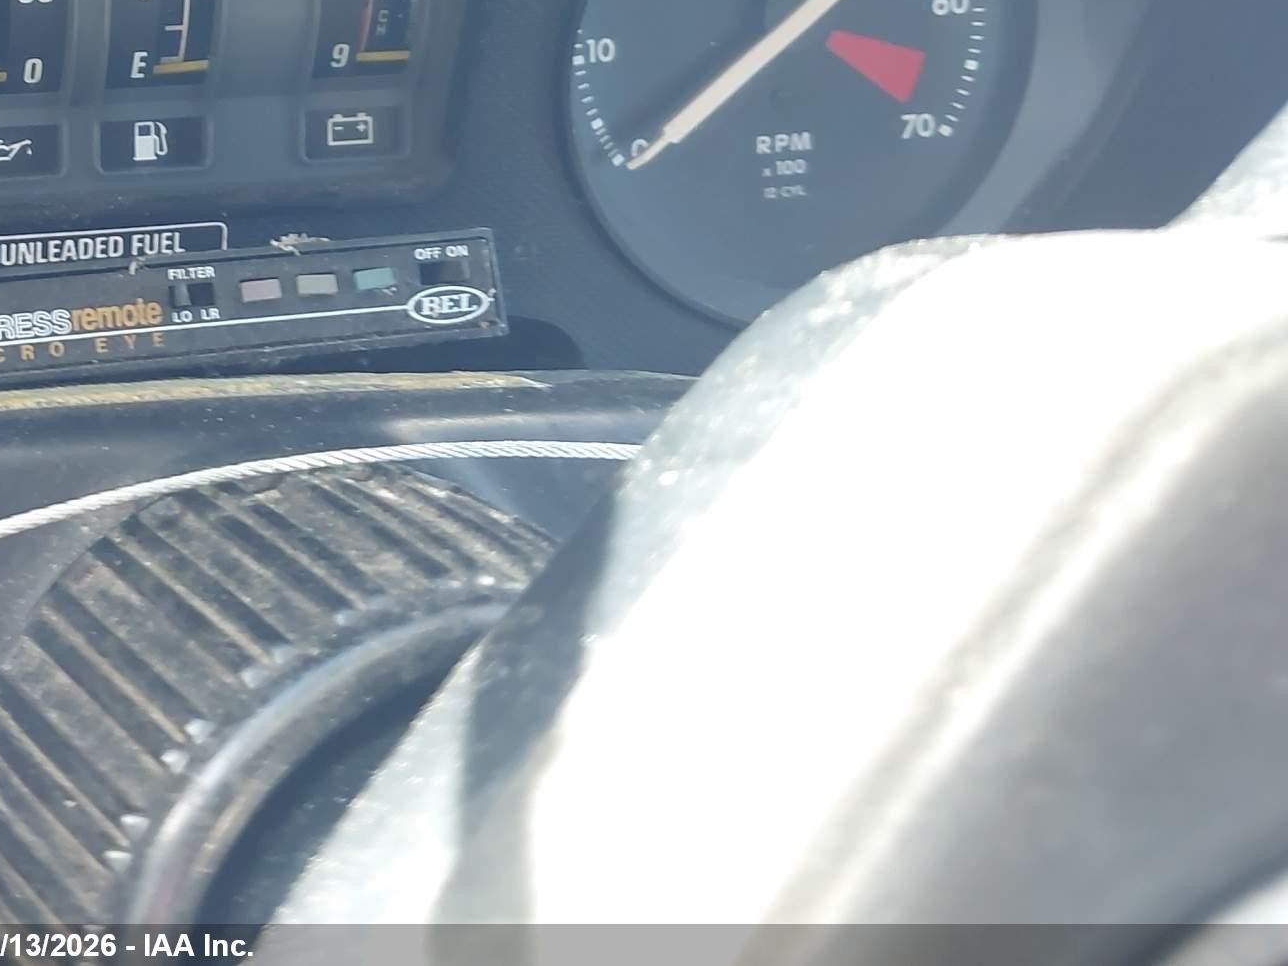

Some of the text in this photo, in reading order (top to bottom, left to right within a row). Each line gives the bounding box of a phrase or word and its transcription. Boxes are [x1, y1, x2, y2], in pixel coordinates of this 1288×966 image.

[330, 44, 350, 68] 9
[586, 37, 615, 63] 10
[23, 58, 43, 84] 0
[130, 51, 148, 78] E
[901, 113, 935, 139] 70
[756, 132, 812, 153] RPM
[0, 231, 186, 265] UNLEADED FUEL
[414, 245, 469, 261] OFF ON
[168, 266, 215, 280] FILTER
[172, 310, 193, 322] LO
[420, 292, 480, 316] BEL
[95, 332, 166, 353] EYE
